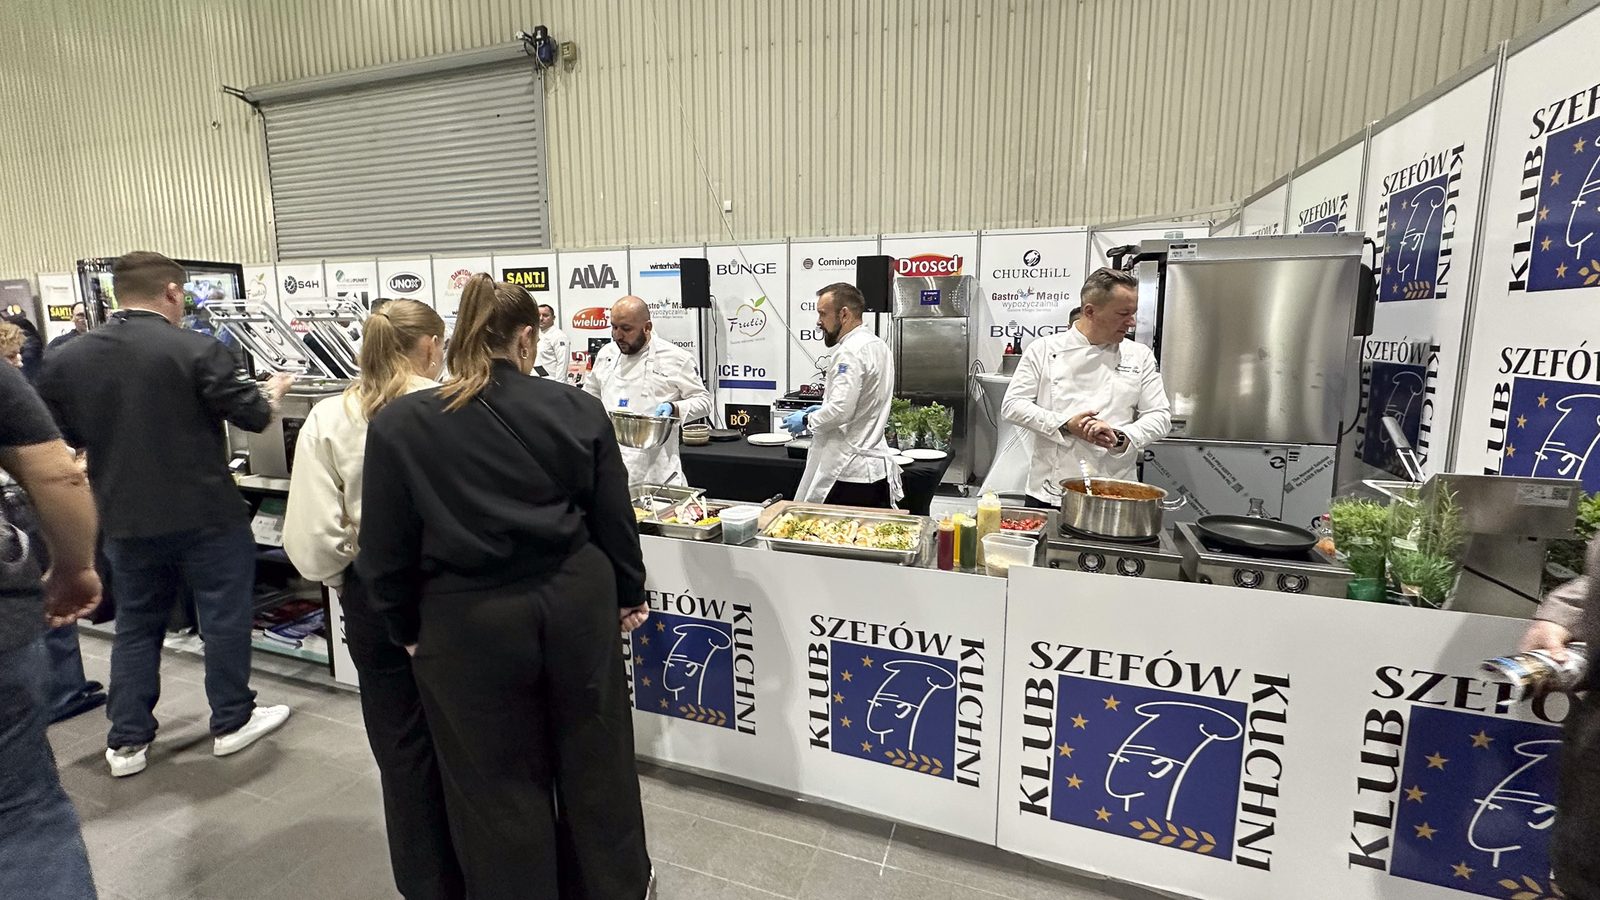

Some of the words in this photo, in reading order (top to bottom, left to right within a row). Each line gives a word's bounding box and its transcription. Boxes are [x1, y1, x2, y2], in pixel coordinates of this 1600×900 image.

[1529, 83, 1600, 139] SZEF
[1381, 148, 1449, 197] SZEFÓW
[1435, 141, 1465, 299] KUCHNI
[1508, 145, 1543, 296] KLUB
[298, 281, 319, 289] S4H
[506, 271, 545, 284] SANTI
[717, 262, 777, 275] BUNGE
[818, 258, 857, 267] Cominpo
[899, 254, 959, 274] Drosed
[991, 292, 1019, 301] Gastro
[1036, 292, 1070, 301] Magic
[727, 317, 764, 332] Frutis
[1365, 336, 1433, 364] SZEFÓW
[718, 365, 739, 377] ICE
[743, 365, 766, 377] Pro
[1417, 345, 1440, 467] KUCH
[1483, 382, 1511, 476] LUB
[645, 589, 727, 620] EFÓW
[809, 614, 953, 656] SZEFÓW
[732, 602, 757, 736] KUCHNI
[1028, 641, 1242, 696] SZEFÓW
[808, 642, 830, 751] KLUB
[956, 638, 986, 788] KUCHNI
[1019, 677, 1055, 817] KLUB
[1236, 673, 1290, 871] KUCHNI
[1348, 708, 1405, 872] KLUB
